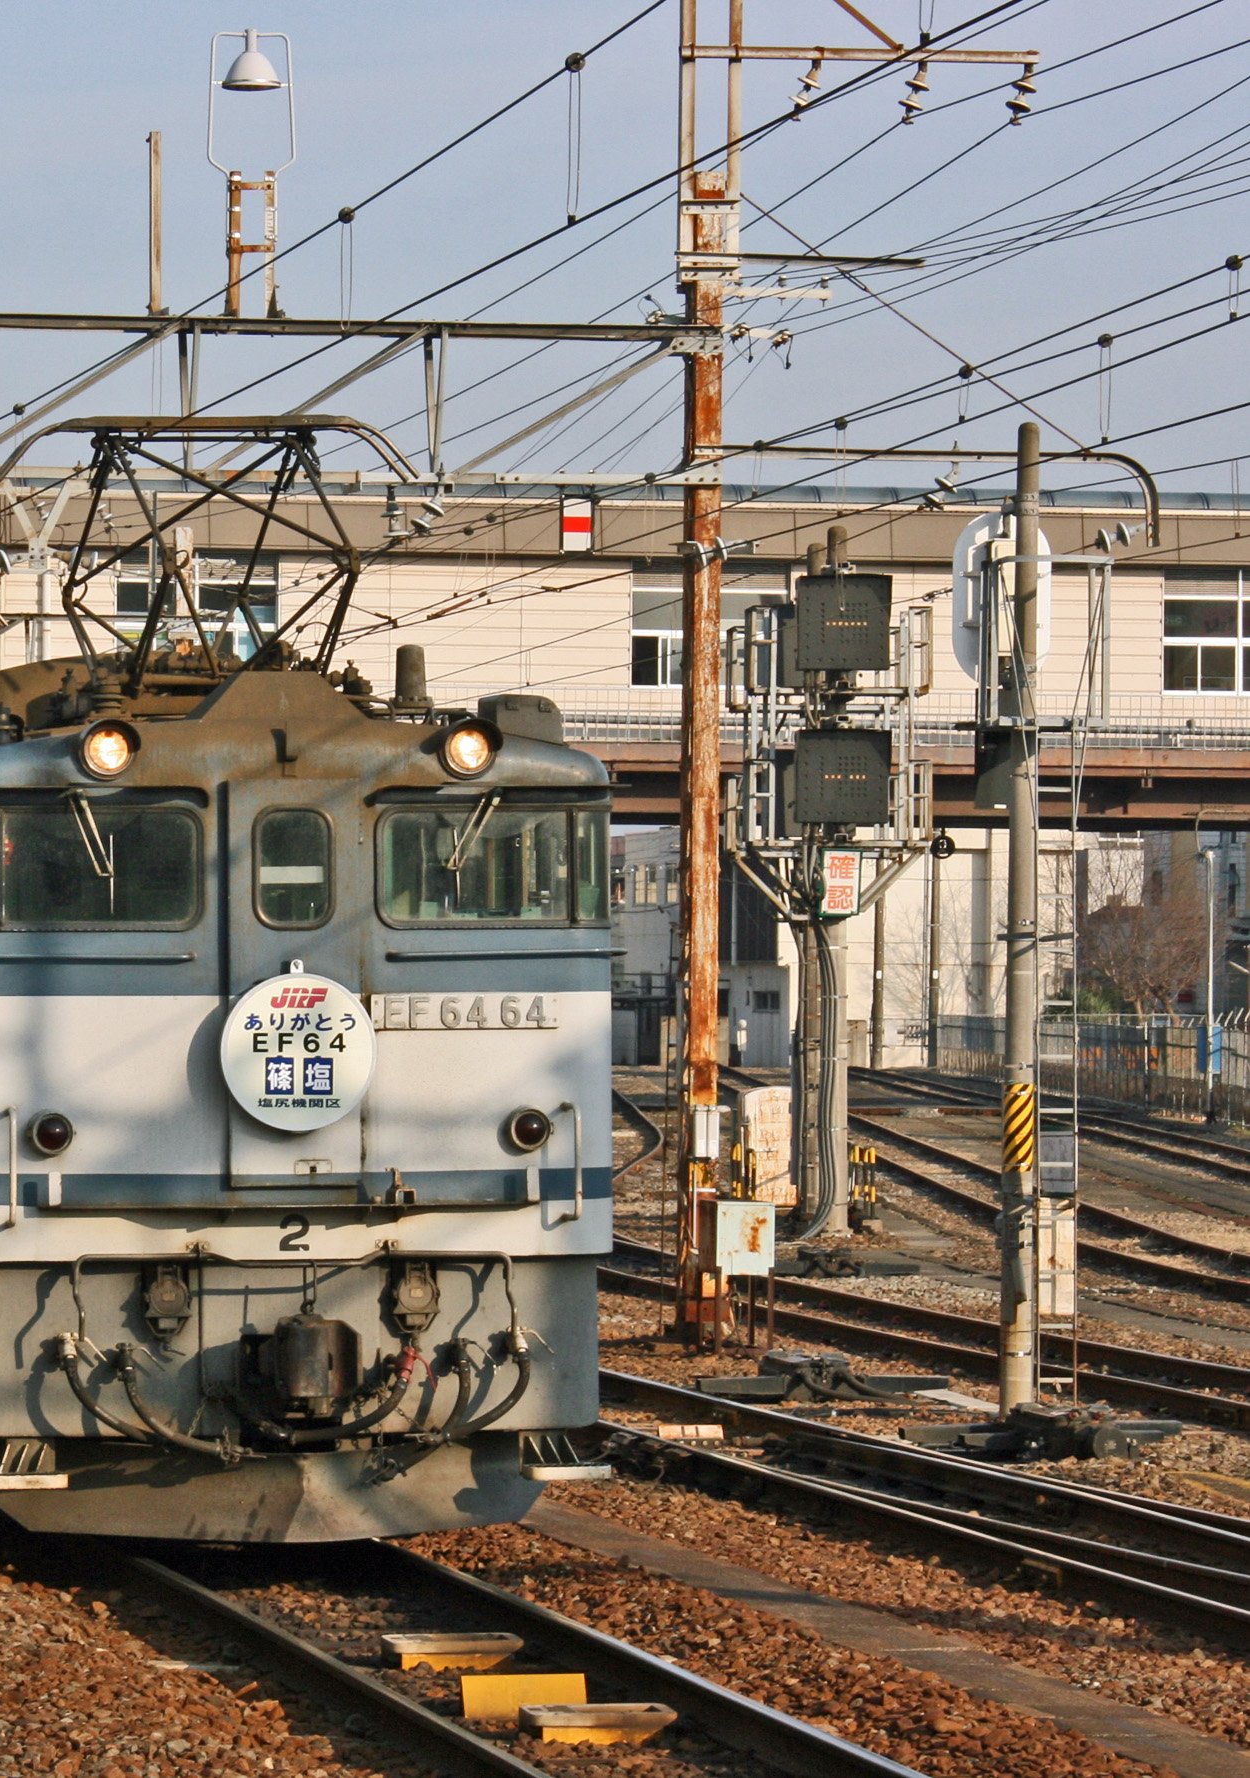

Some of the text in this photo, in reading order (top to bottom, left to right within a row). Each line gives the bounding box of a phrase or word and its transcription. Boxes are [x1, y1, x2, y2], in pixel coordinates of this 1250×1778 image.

[827, 855, 855, 909] 確認
[270, 988, 329, 1008] JRF
[244, 1013, 357, 1031] ありがとう
[500, 995, 546, 1029] 64
[252, 1032, 346, 1053] EF64
[257, 1097, 342, 1109] 塩尻機関区
[279, 1213, 310, 1252] 2
